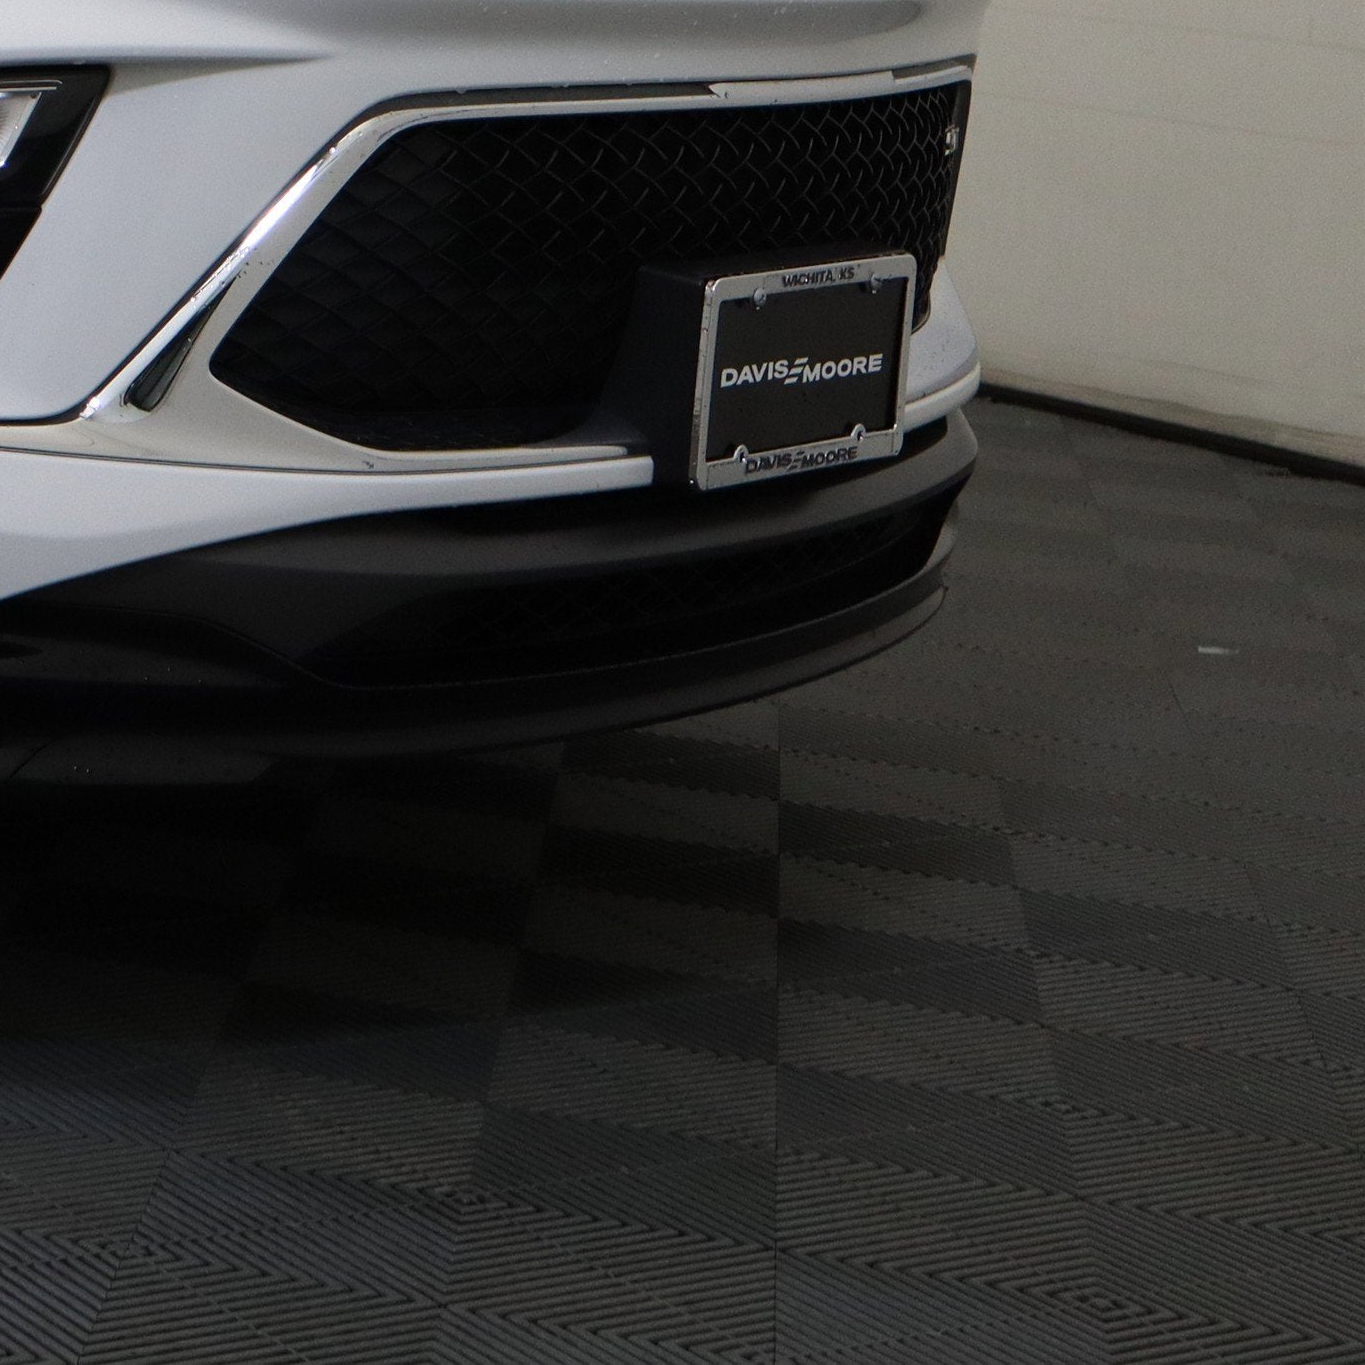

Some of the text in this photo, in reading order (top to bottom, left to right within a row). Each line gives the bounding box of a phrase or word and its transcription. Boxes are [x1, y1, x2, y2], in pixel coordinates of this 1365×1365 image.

[839, 266, 855, 280] KS
[720, 353, 883, 388] DAVIS MOORE
[744, 446, 859, 474] DAVIS MOORE
